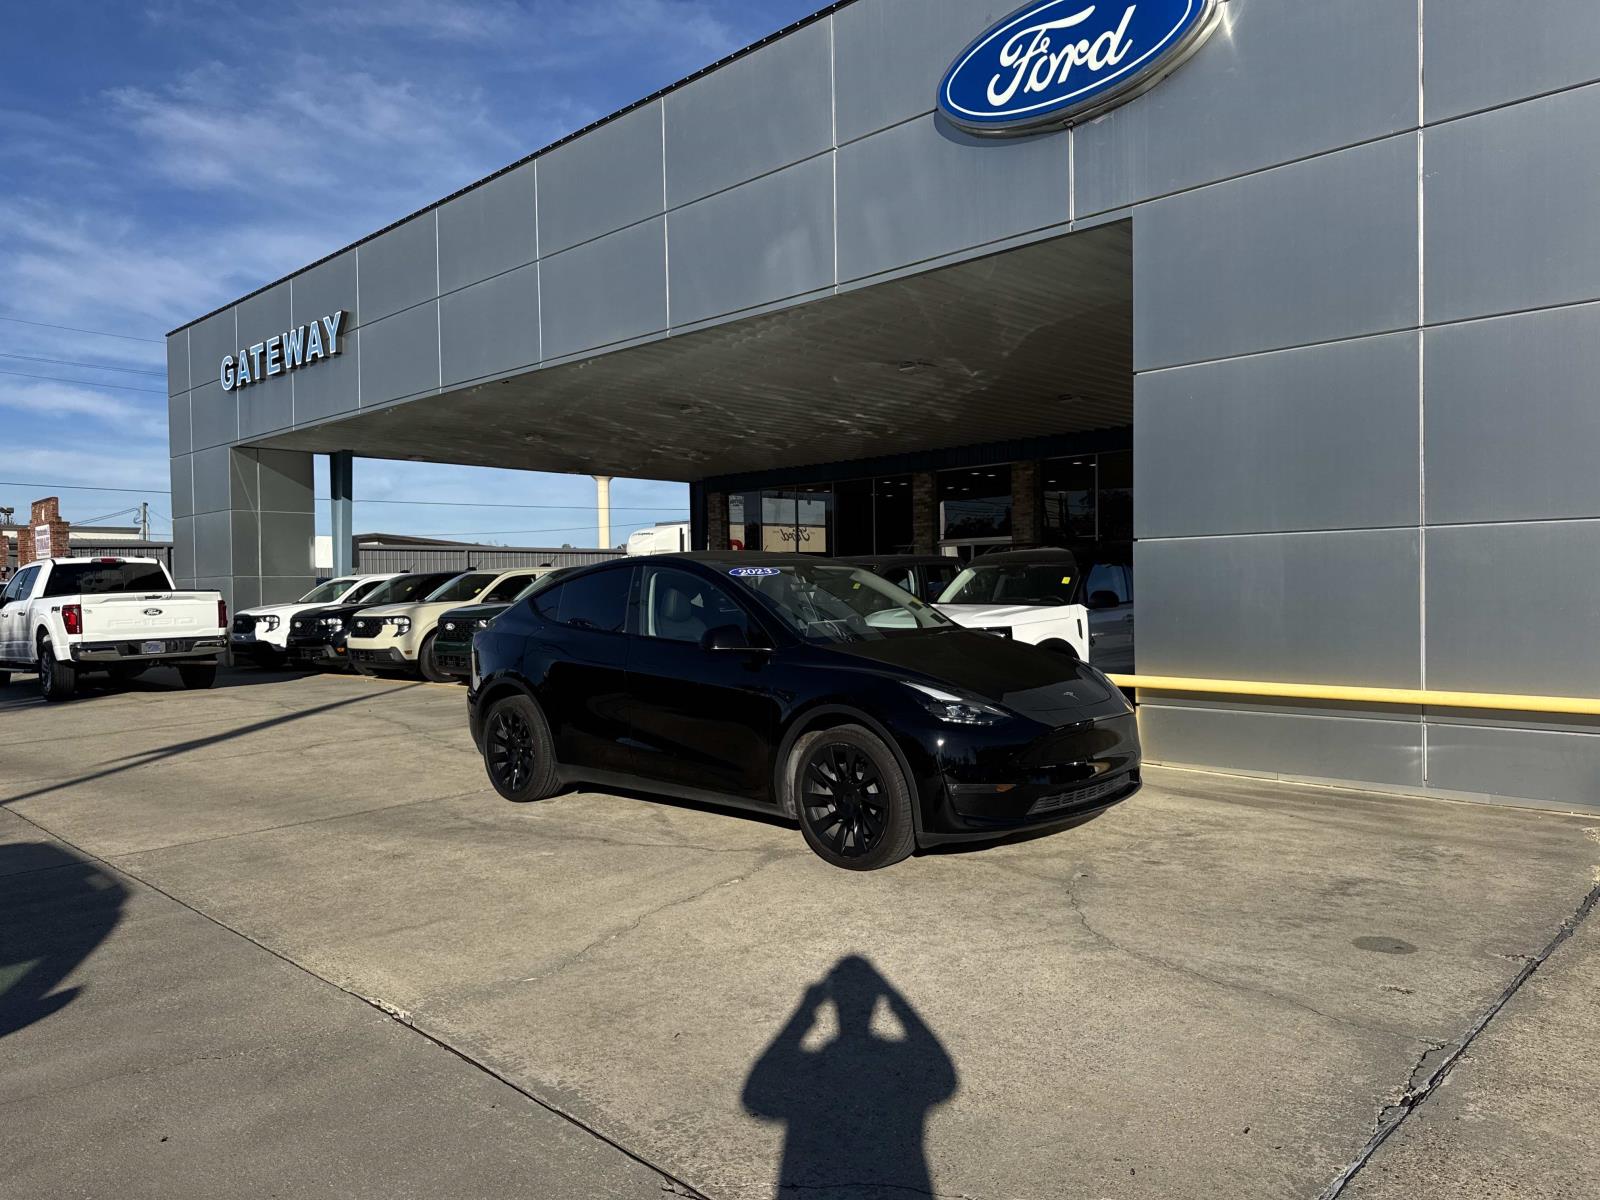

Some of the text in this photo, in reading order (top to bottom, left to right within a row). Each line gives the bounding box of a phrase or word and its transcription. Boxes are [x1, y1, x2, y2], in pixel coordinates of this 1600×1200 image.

[986, 4, 1136, 106] Ford
[220, 310, 343, 391] GATEWAY
[738, 567, 773, 576] 2023
